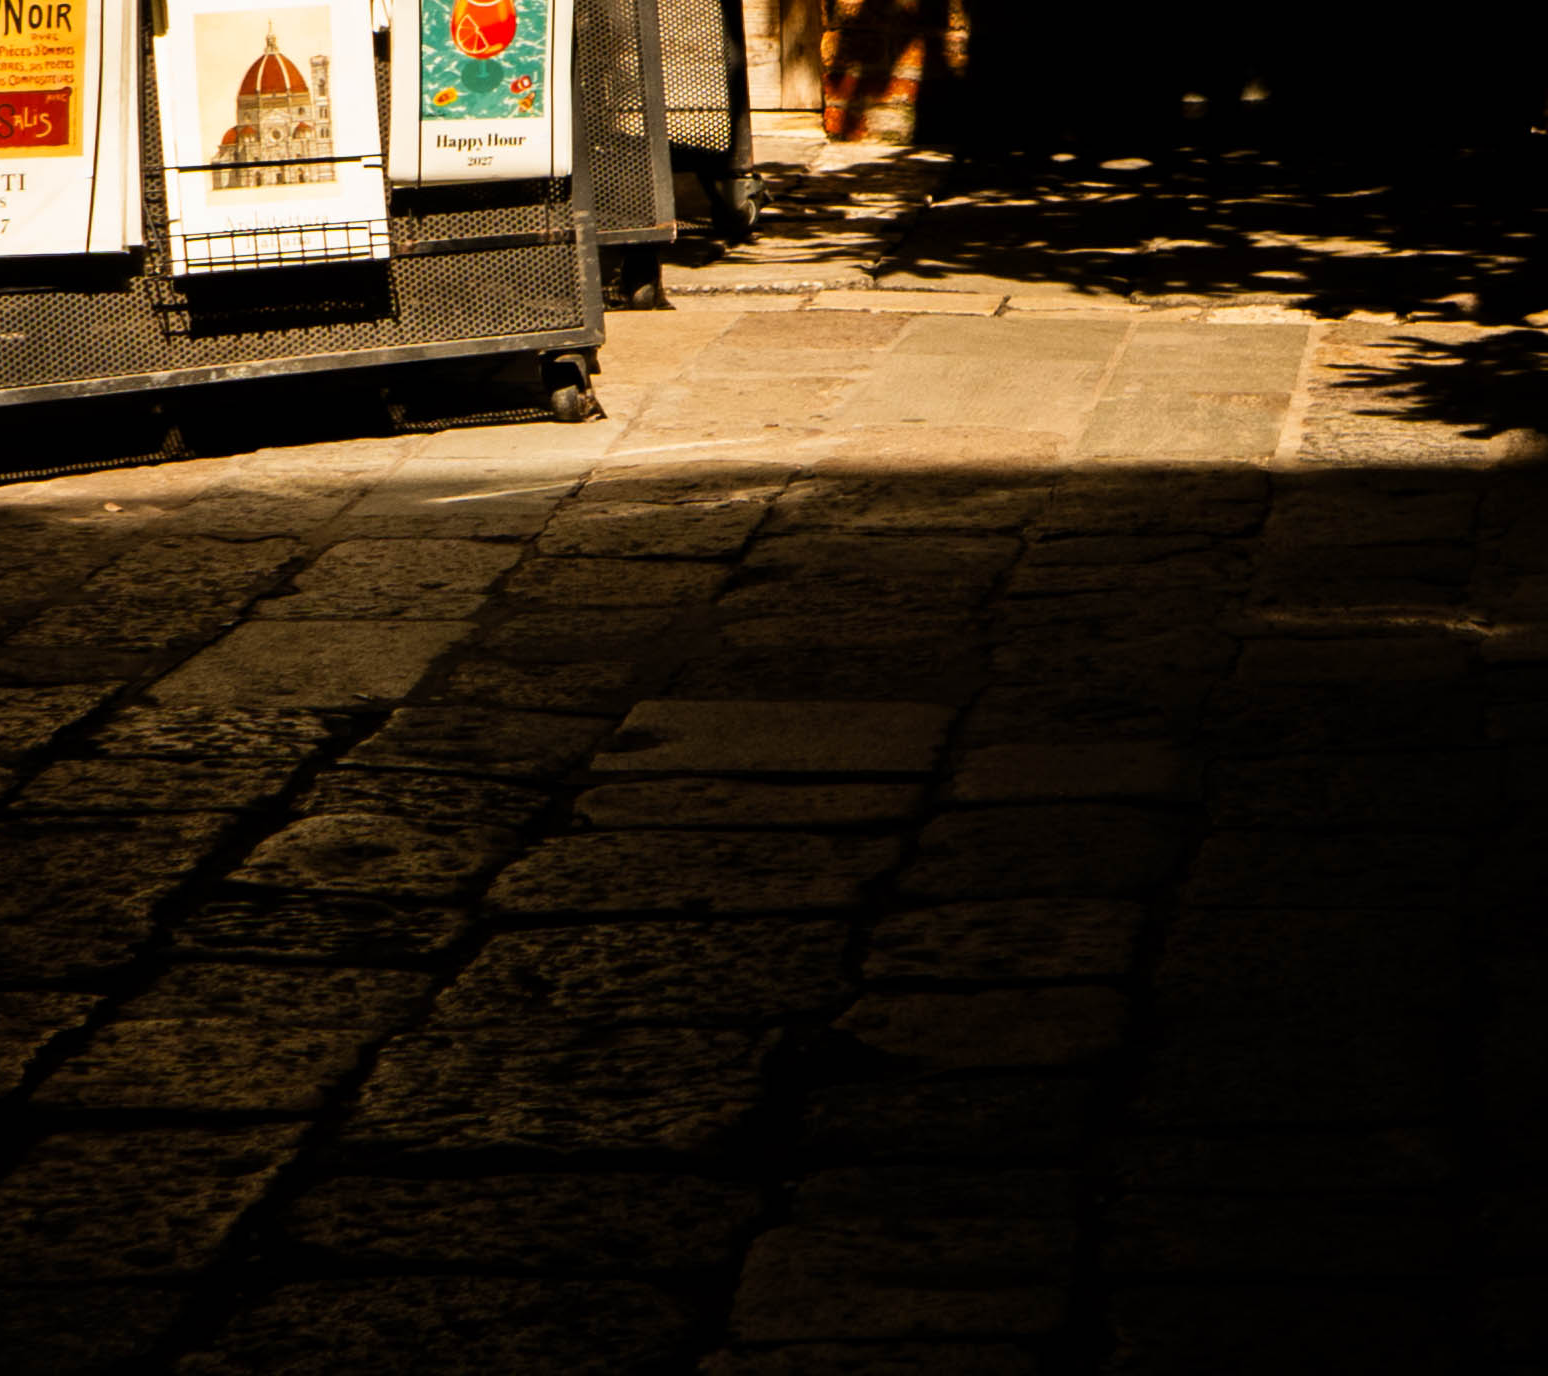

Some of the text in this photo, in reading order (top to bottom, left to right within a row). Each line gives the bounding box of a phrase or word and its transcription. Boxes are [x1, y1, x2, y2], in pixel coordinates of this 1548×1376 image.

[436, 133, 527, 152] Happy Hour
[466, 155, 493, 167] 2027
